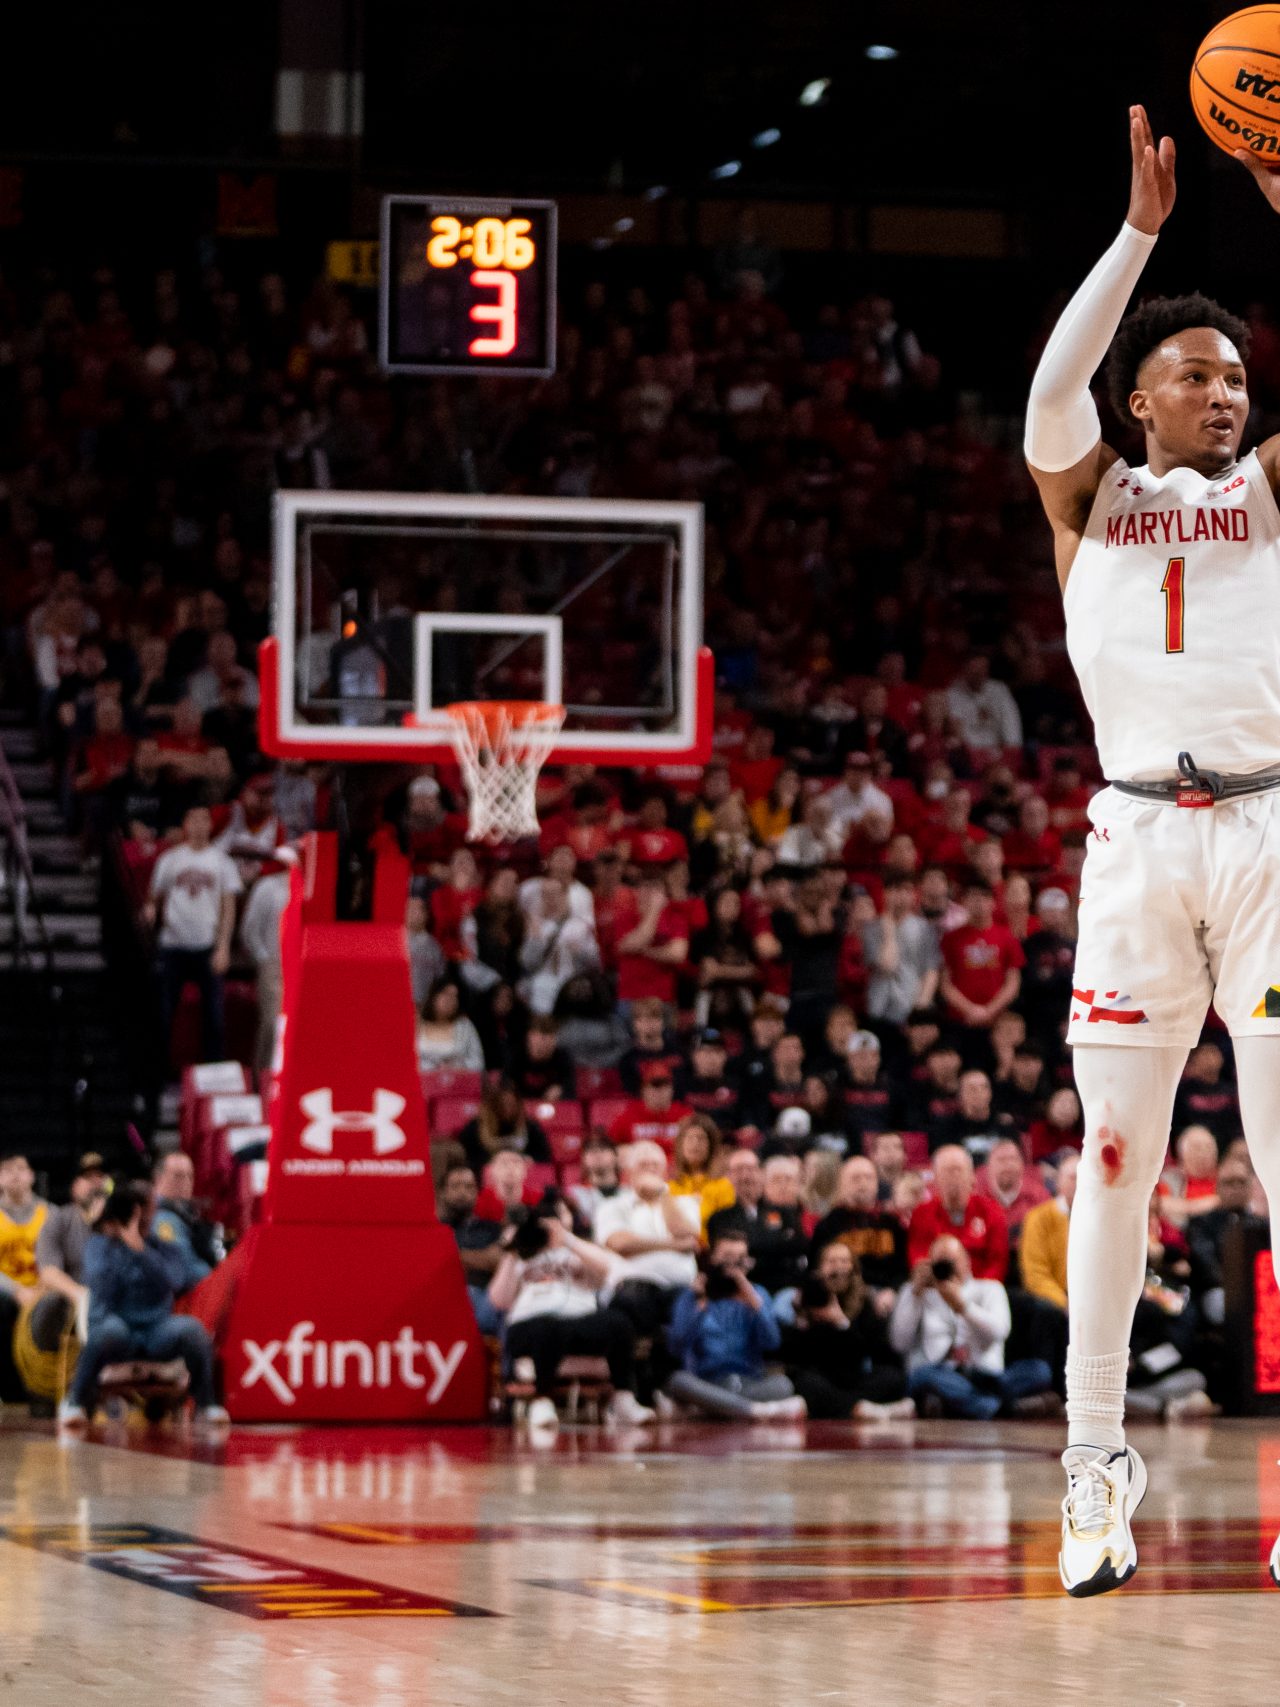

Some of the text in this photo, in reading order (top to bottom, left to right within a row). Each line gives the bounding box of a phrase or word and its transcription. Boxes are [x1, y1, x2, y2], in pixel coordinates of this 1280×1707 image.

[426, 216, 536, 270] 2:06
[469, 270, 519, 357] 3
[1106, 506, 1249, 548] MARYLAND
[1160, 557, 1185, 654] 1
[240, 1320, 469, 1405] xfinity
